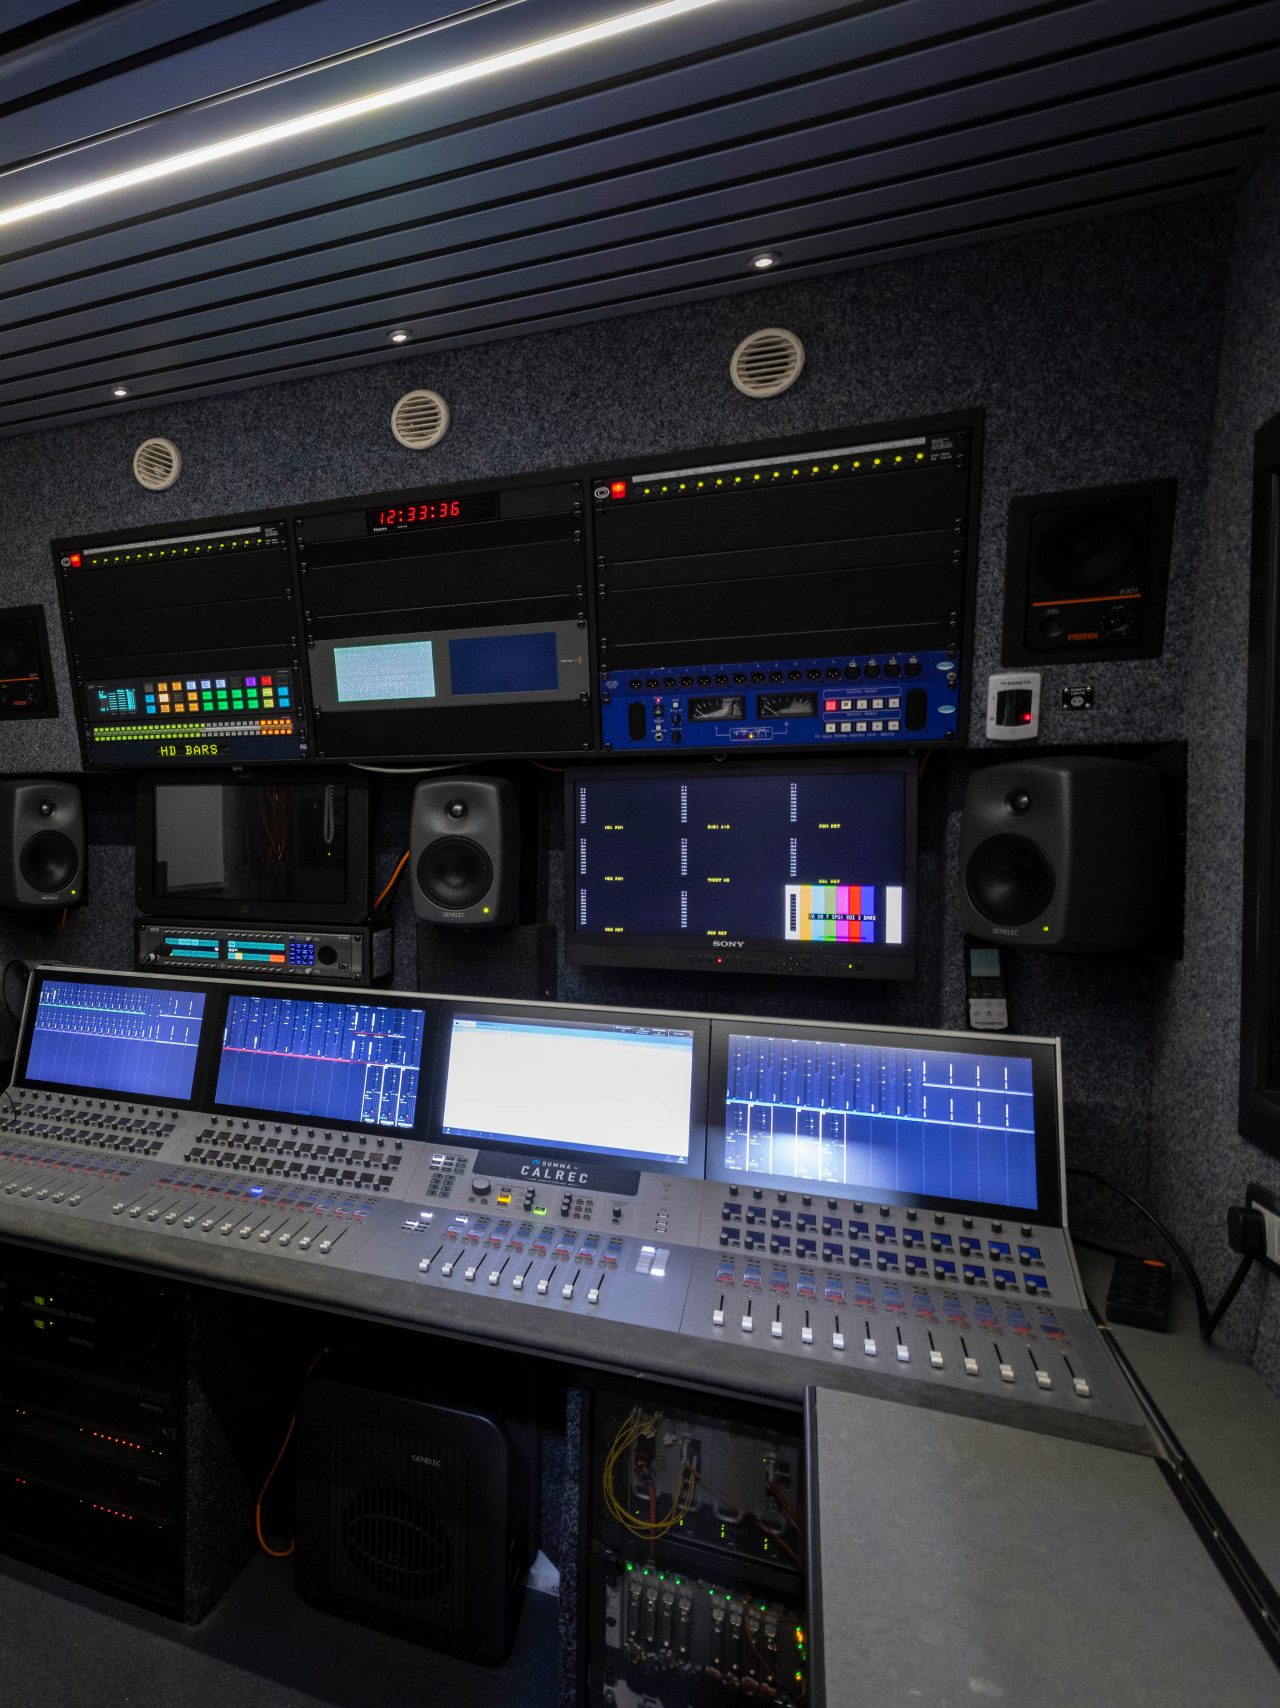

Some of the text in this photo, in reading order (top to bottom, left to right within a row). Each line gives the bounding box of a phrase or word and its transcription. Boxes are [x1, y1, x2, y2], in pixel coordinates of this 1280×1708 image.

[380, 501, 460, 525] 12:33:36
[160, 744, 218, 756] HD BARS
[992, 928, 1019, 936] GENELEC
[712, 940, 745, 948] SONY
[542, 1161, 571, 1170] SUMMA
[521, 1165, 588, 1184] CALREC
